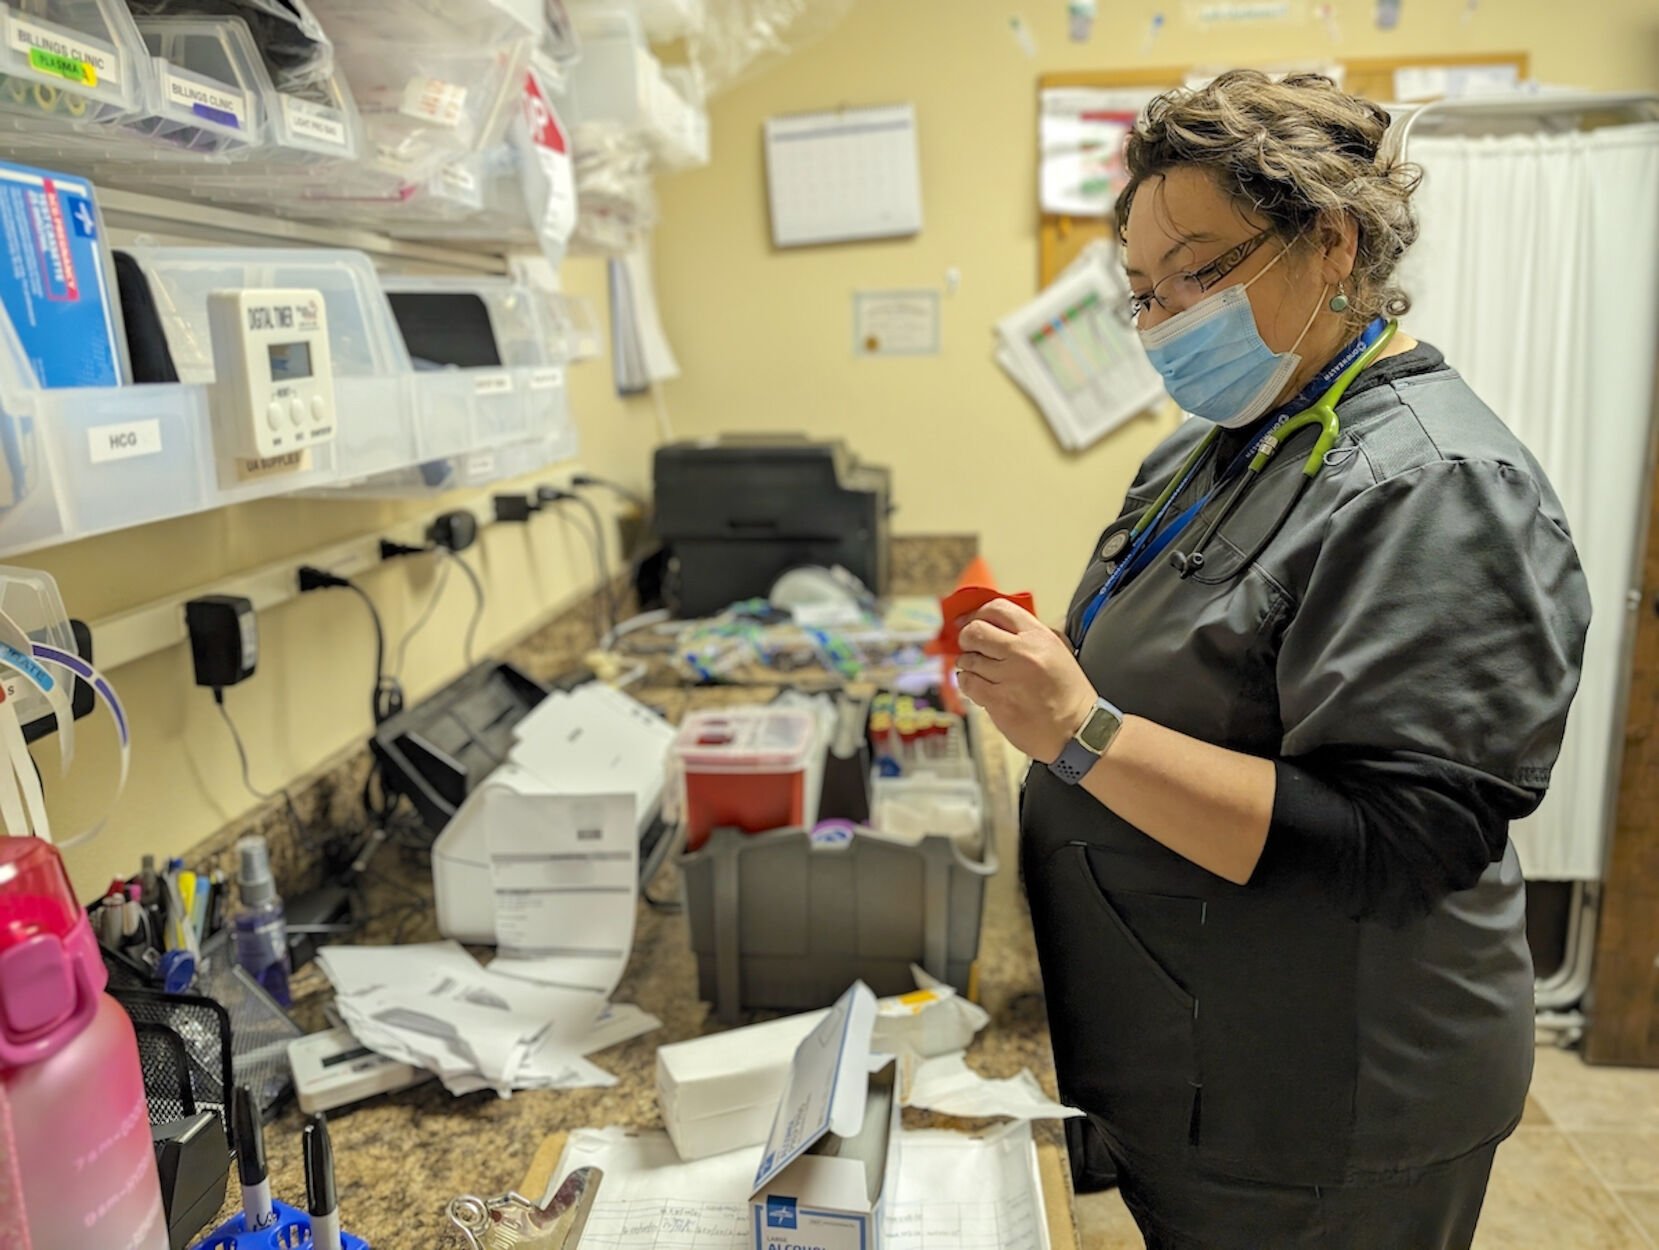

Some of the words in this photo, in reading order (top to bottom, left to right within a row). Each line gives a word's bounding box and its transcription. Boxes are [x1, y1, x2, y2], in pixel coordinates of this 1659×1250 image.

[39, 55, 77, 73] PLASMA
[70, 48, 105, 70] CLINIC
[172, 84, 207, 103] BILLINGS
[209, 97, 233, 111] CLINIC
[247, 306, 274, 331] DIGITAL
[274, 305, 295, 329] TIMER
[108, 431, 137, 450] HCG
